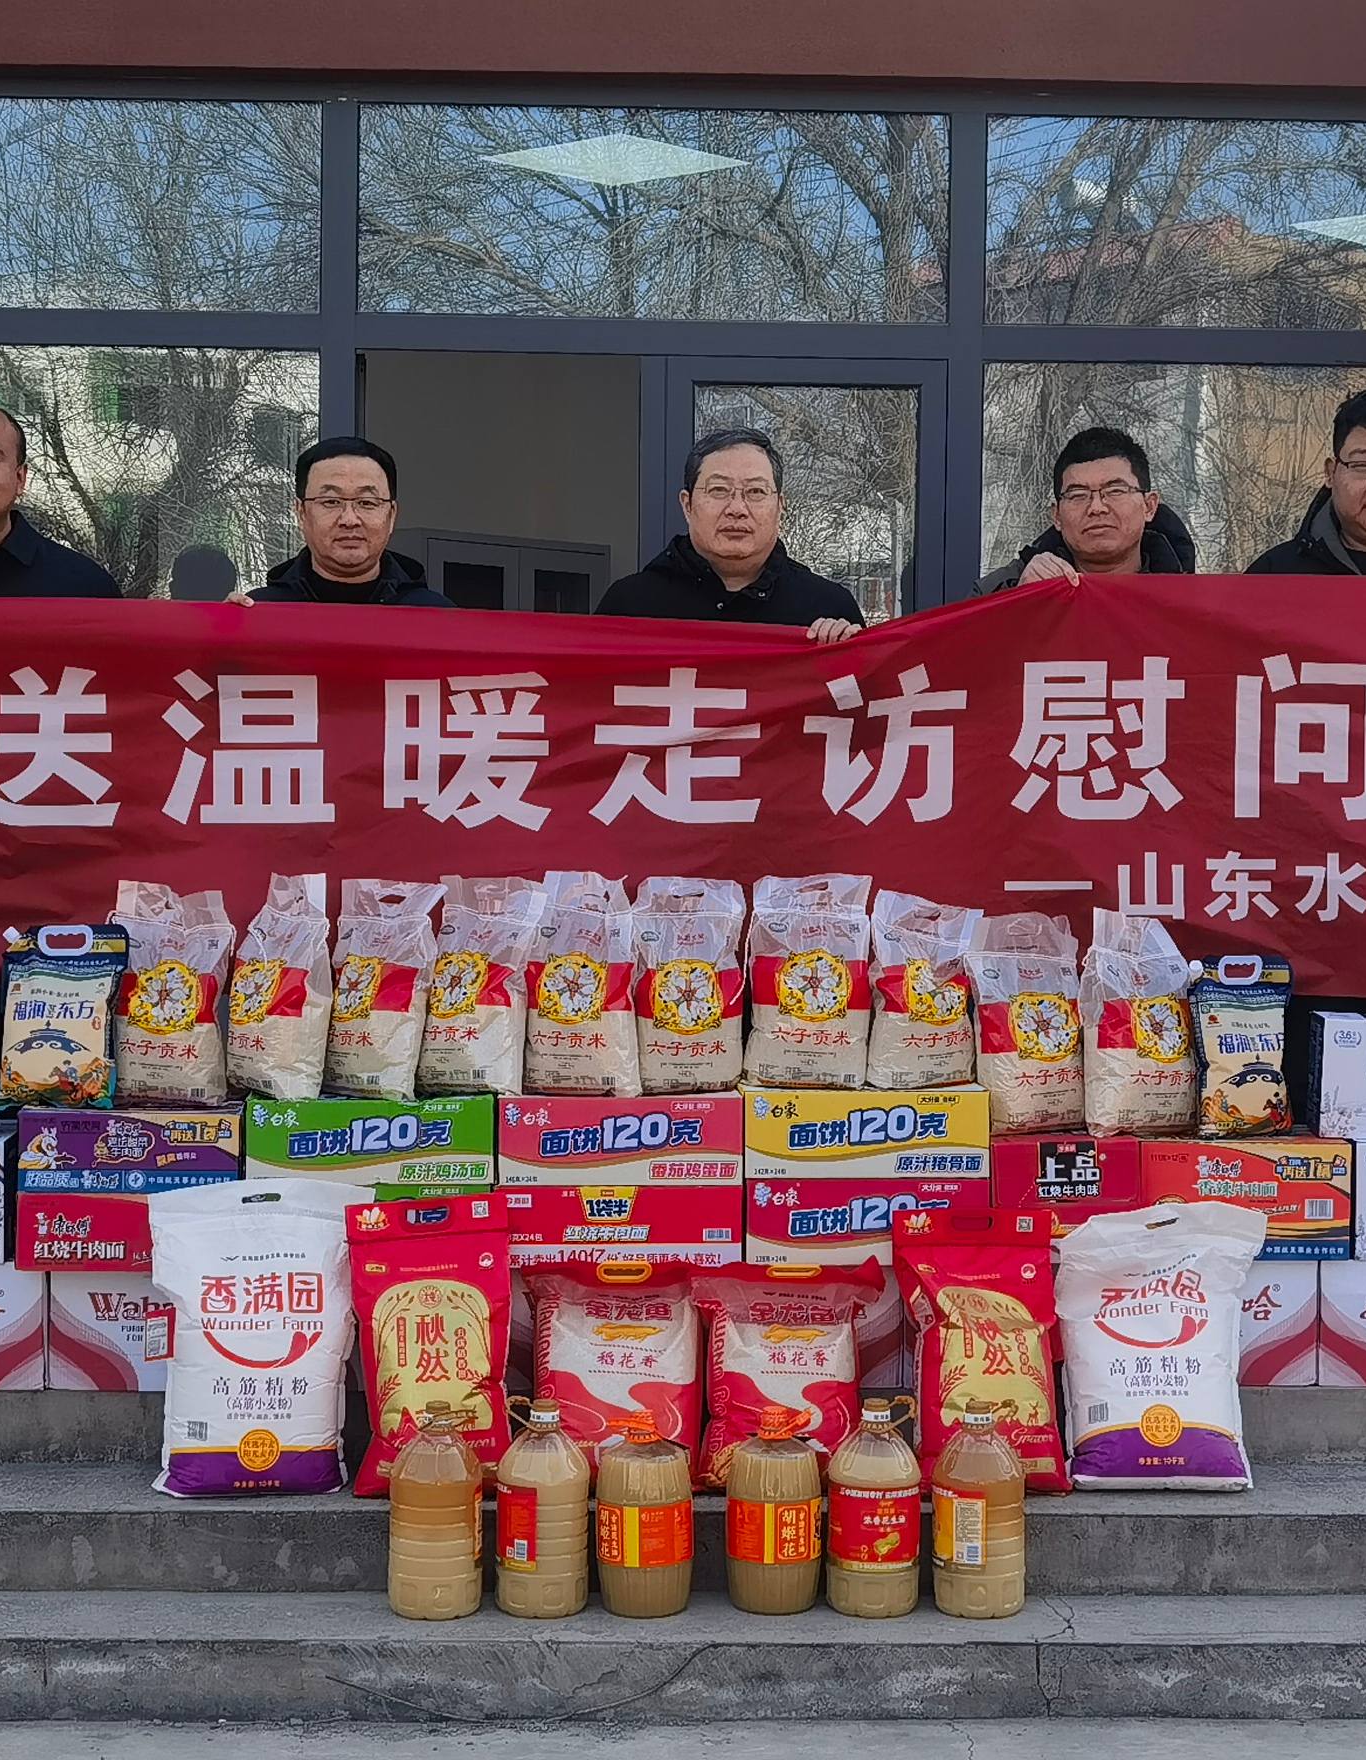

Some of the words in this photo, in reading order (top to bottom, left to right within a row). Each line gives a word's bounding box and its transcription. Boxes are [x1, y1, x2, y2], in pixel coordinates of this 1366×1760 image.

[532, 1029, 607, 1049] 六子贡米
[771, 1026, 851, 1046] 六子贡米
[902, 1025, 972, 1048] 六子贡米
[120, 1038, 199, 1060] 六子贡米
[646, 1039, 727, 1057] 六子贡米
[1015, 1066, 1084, 1089] 六子贡米
[288, 1113, 453, 1159] 面饼120克
[539, 1112, 704, 1157] 面饼120克
[787, 1105, 948, 1150] 面饼120克
[110, 1147, 144, 1158] 牛肉面
[895, 1153, 983, 1173] 原汁猪骨面
[397, 1161, 489, 1182] 原汁鸡汤面
[649, 1161, 738, 1180] 番茄鸡蛋面
[1036, 1154, 1100, 1182] 上品
[1038, 1184, 1099, 1198] 红烧牛肉味
[1197, 1179, 1278, 1198] 香辣牛肉面
[53, 1213, 92, 1238] 康师傅
[34, 1240, 125, 1260] 红烧牛肉面
[200, 1271, 325, 1315] 香满园
[584, 1300, 673, 1321] 金龙鱼
[748, 1301, 837, 1326] 金龙鱼
[1093, 1300, 1163, 1319] Wonder
[1170, 1301, 1209, 1318] Farm
[201, 1316, 275, 1331] Wonder
[282, 1316, 324, 1331] Farm
[414, 1312, 452, 1384] 秋然
[596, 1350, 659, 1369] 稻花香
[767, 1350, 830, 1368] 稻花香
[1108, 1355, 1202, 1377] 高筋精粉
[212, 1376, 309, 1396] 高筋精粉
[781, 1509, 797, 1558] 胡姬花
